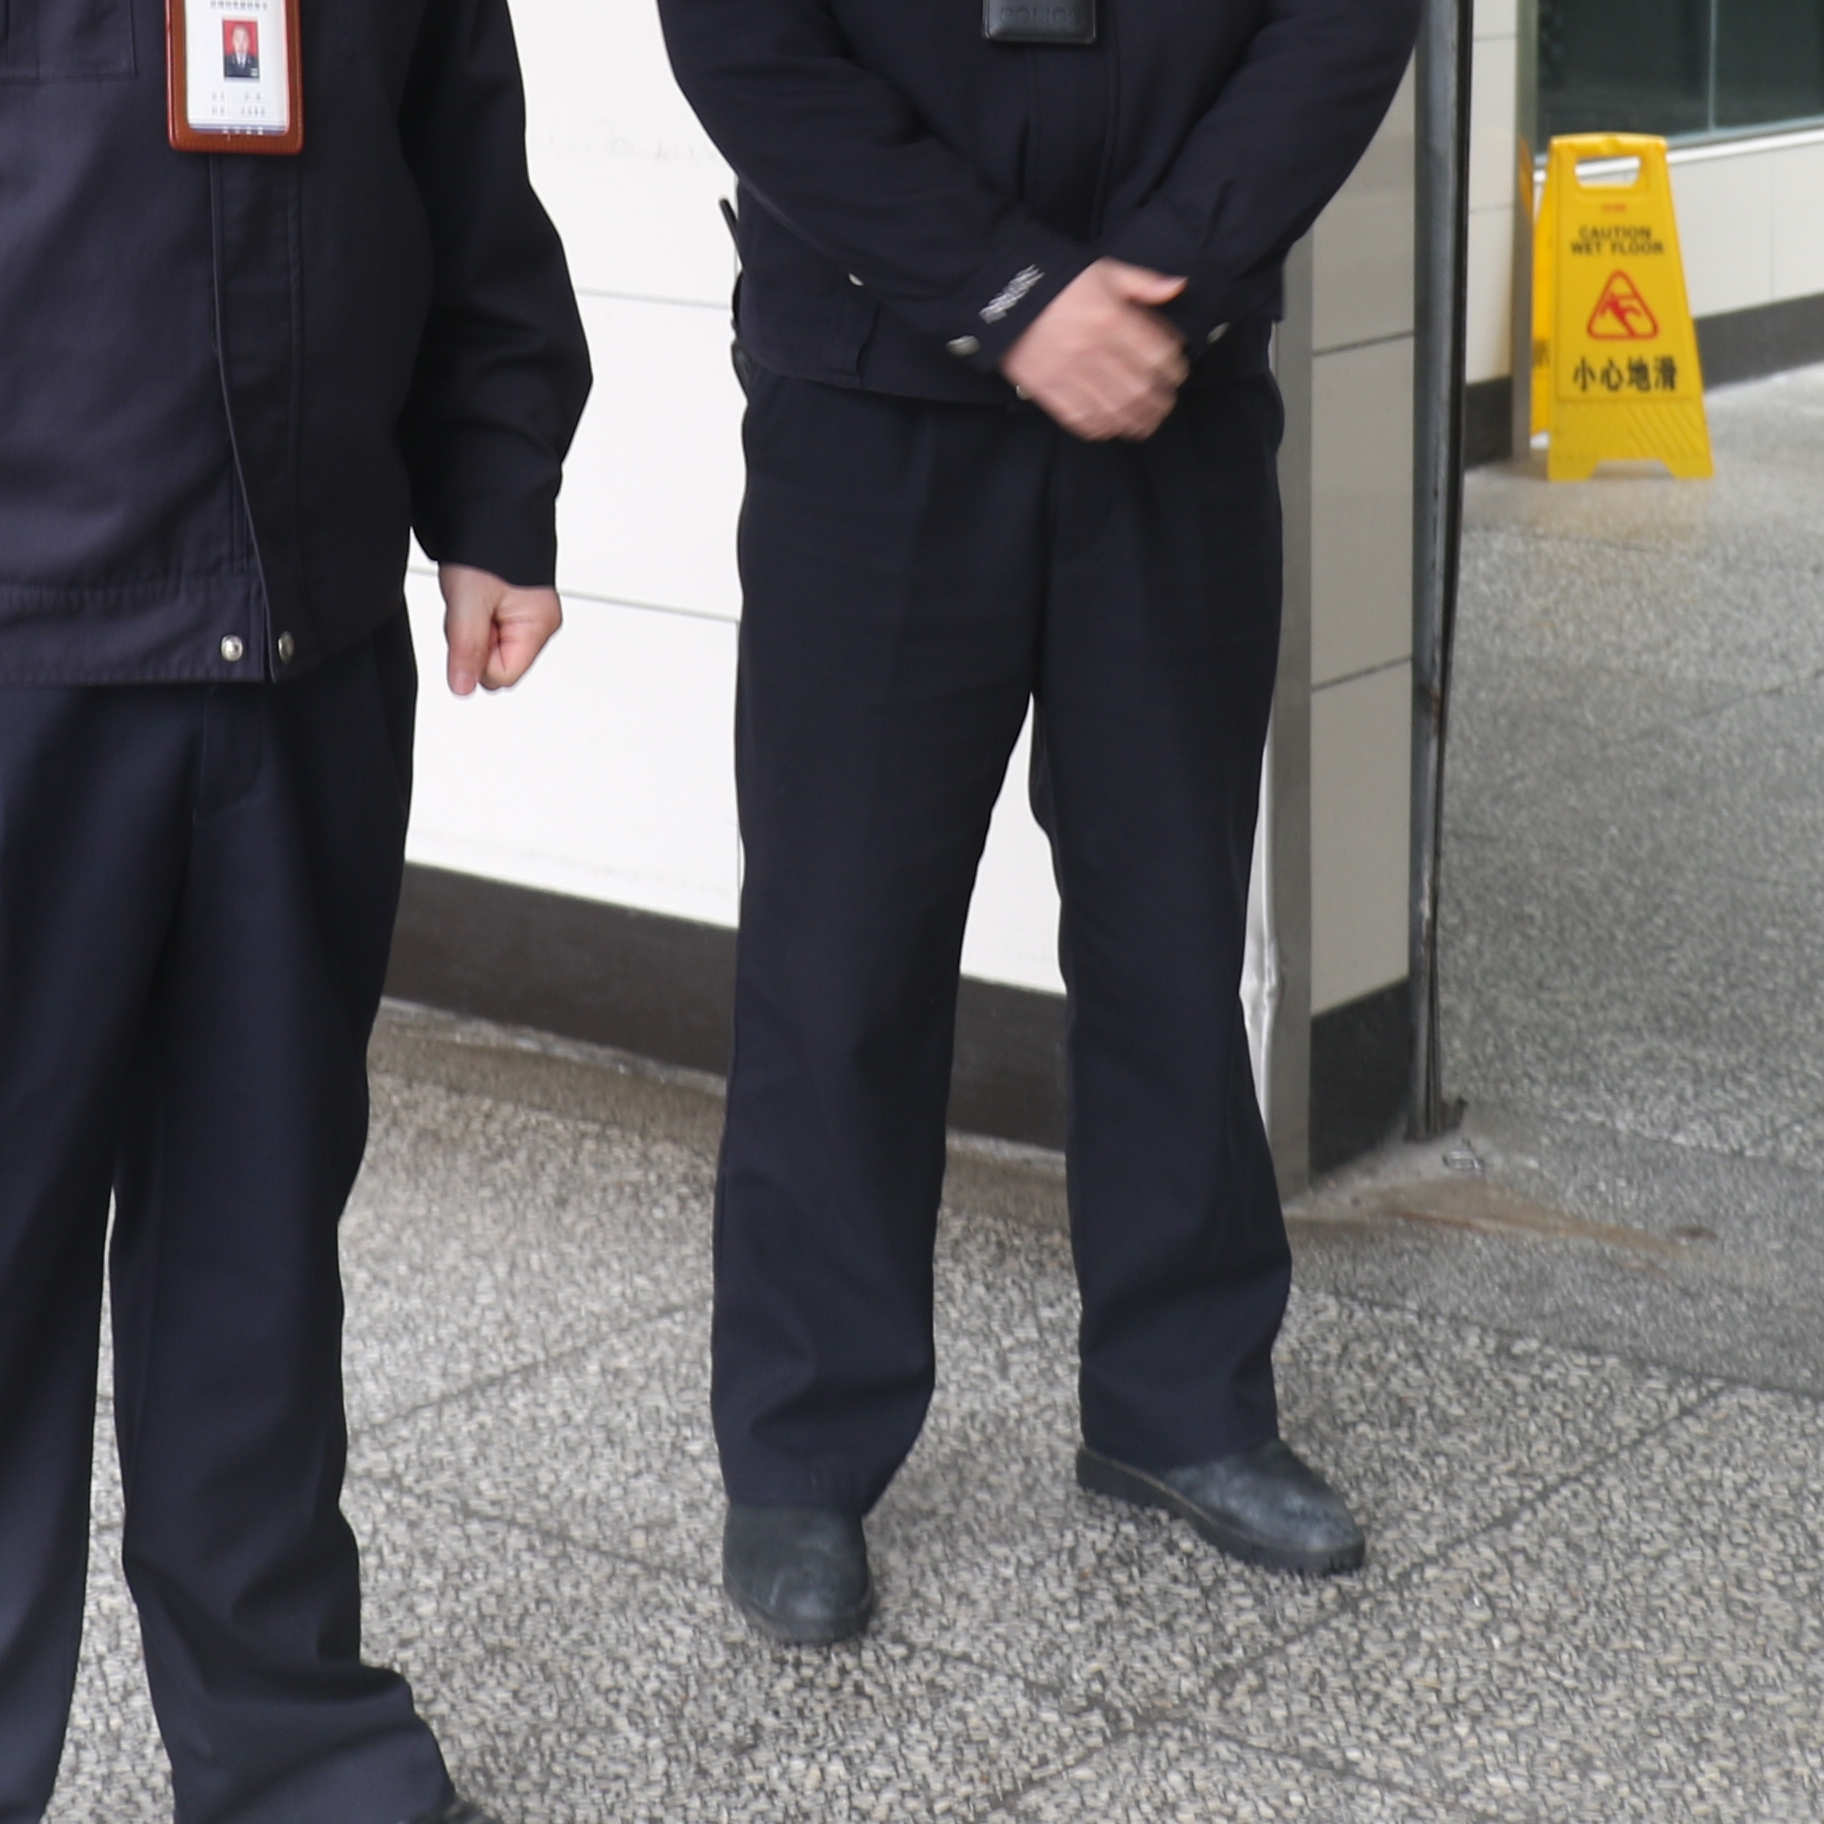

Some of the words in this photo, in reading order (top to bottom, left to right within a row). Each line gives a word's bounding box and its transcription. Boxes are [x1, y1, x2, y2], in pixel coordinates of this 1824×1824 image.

[1578, 226, 1651, 240] CAUTION
[1573, 354, 1676, 392] 小心地滑
